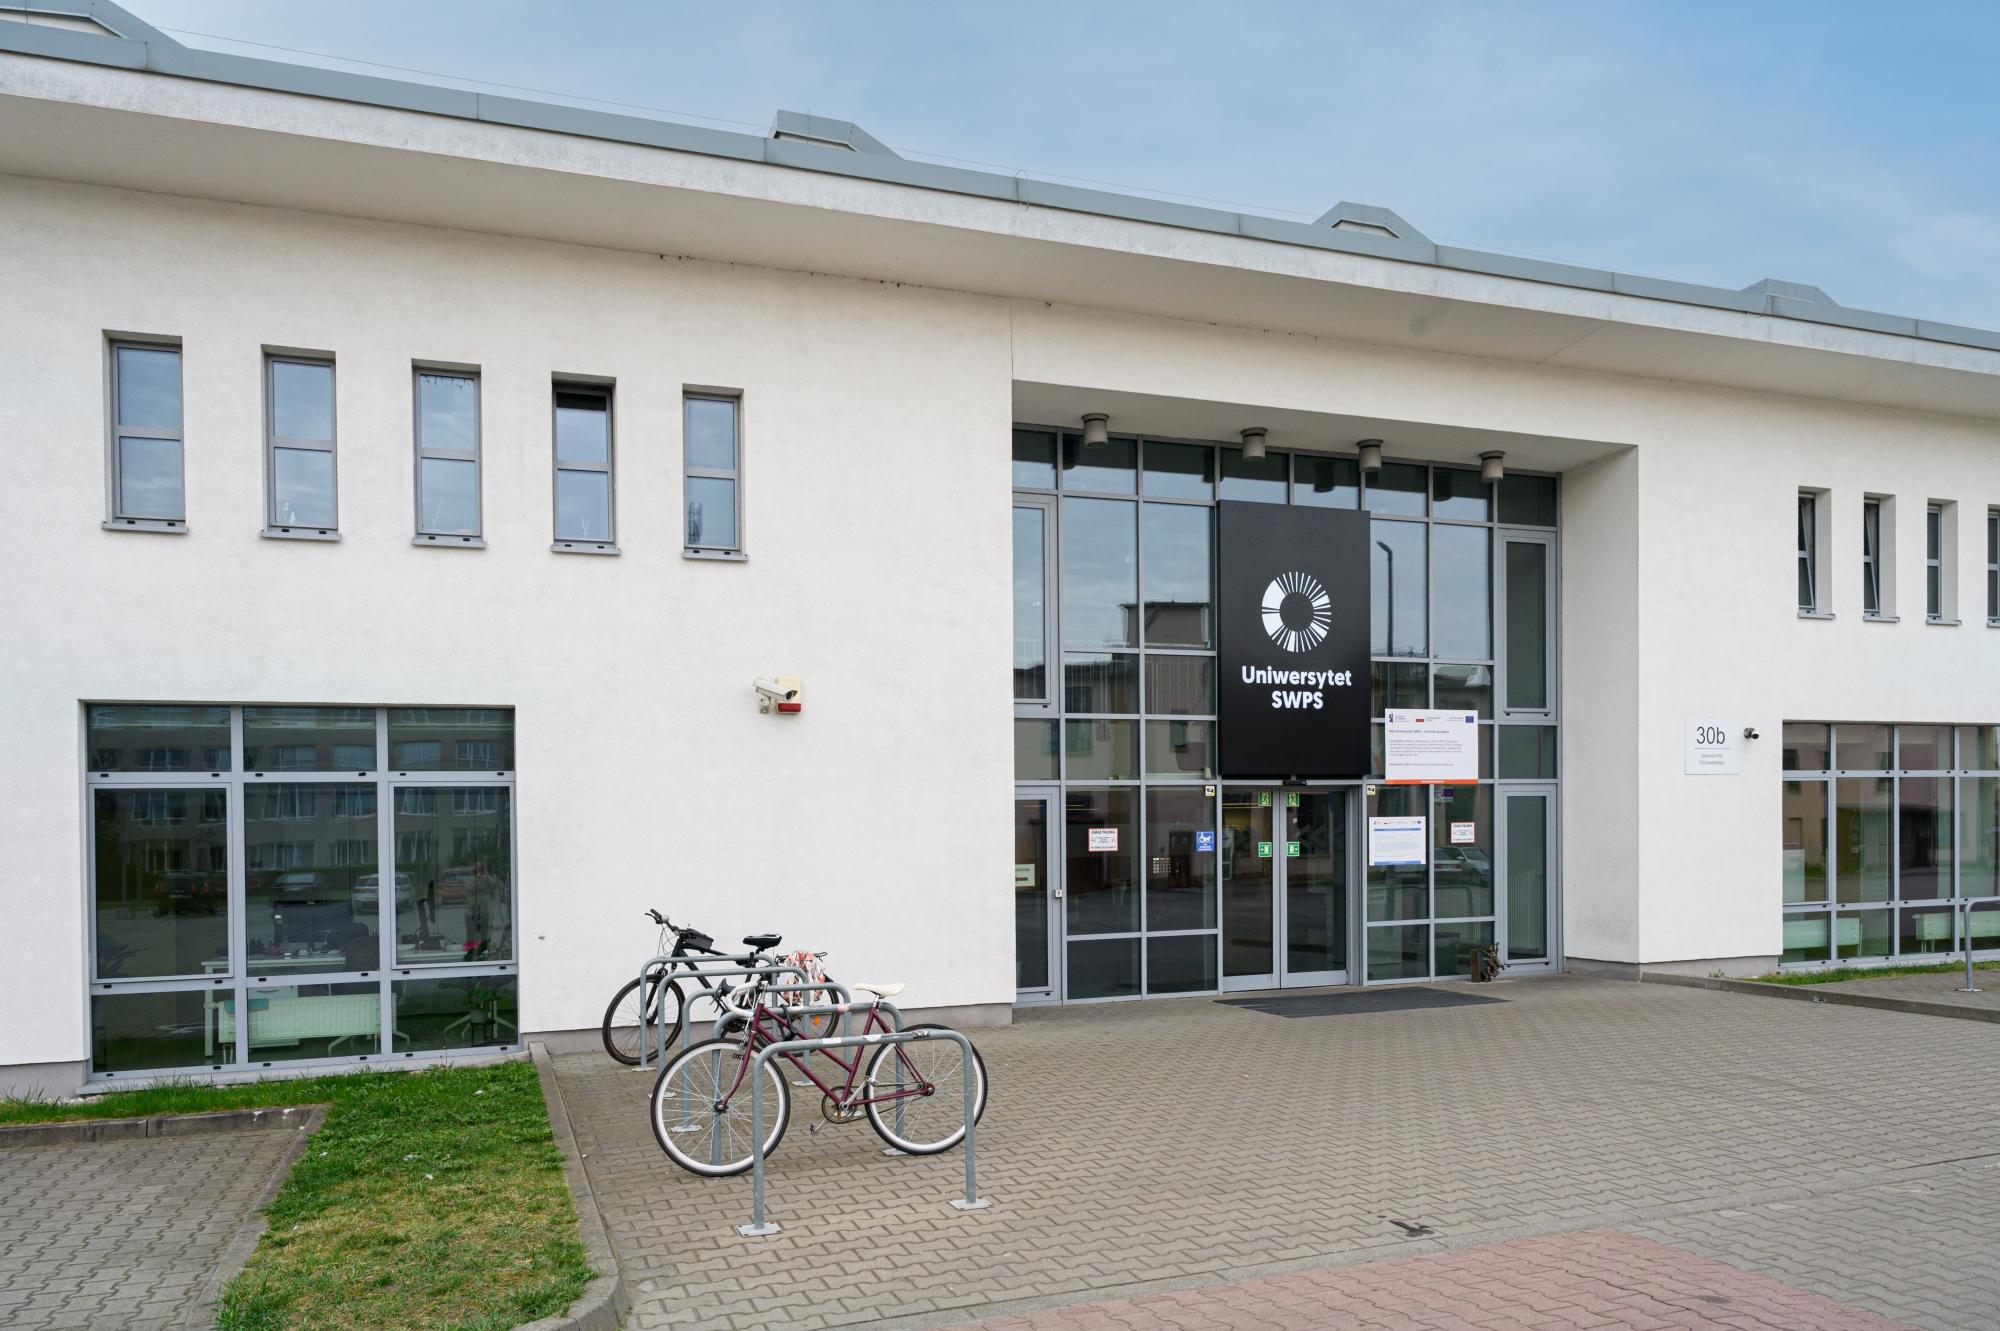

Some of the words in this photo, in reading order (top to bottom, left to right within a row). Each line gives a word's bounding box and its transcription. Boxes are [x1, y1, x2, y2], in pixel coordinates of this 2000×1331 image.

[1241, 665, 1352, 690] Uniwersytet
[1271, 690, 1324, 710] SWPS
[1696, 726, 1726, 745] 30b
